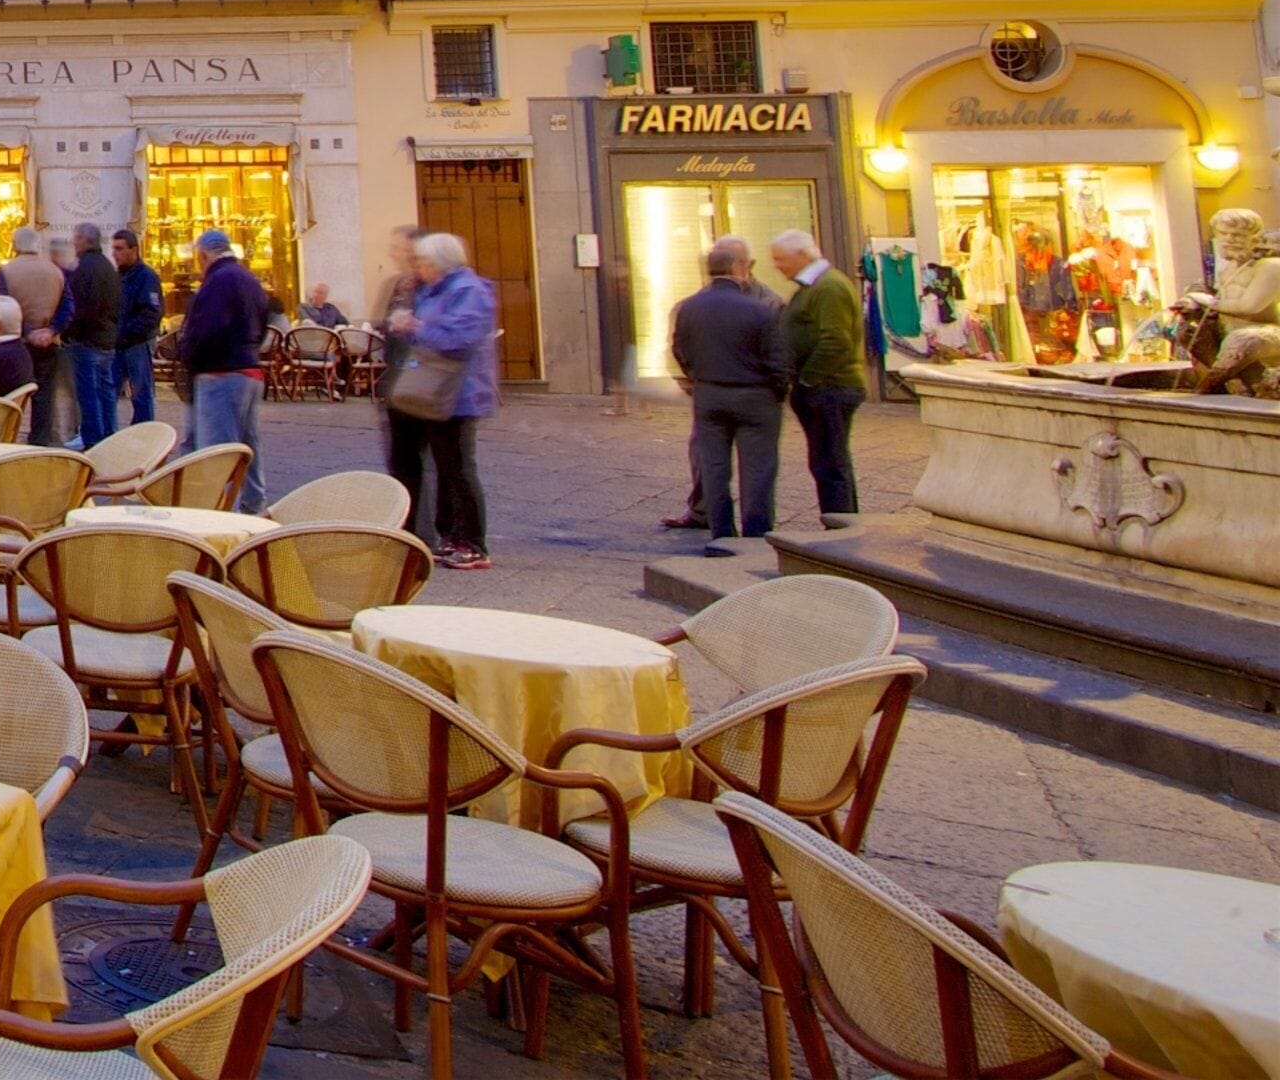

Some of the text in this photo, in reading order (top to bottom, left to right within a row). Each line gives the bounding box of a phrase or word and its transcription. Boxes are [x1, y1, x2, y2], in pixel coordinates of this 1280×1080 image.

[112, 58, 262, 83] PANSA
[618, 103, 814, 133] FARMACIA
[172, 127, 257, 146] Caffetteria
[676, 155, 757, 177] Medaglia
